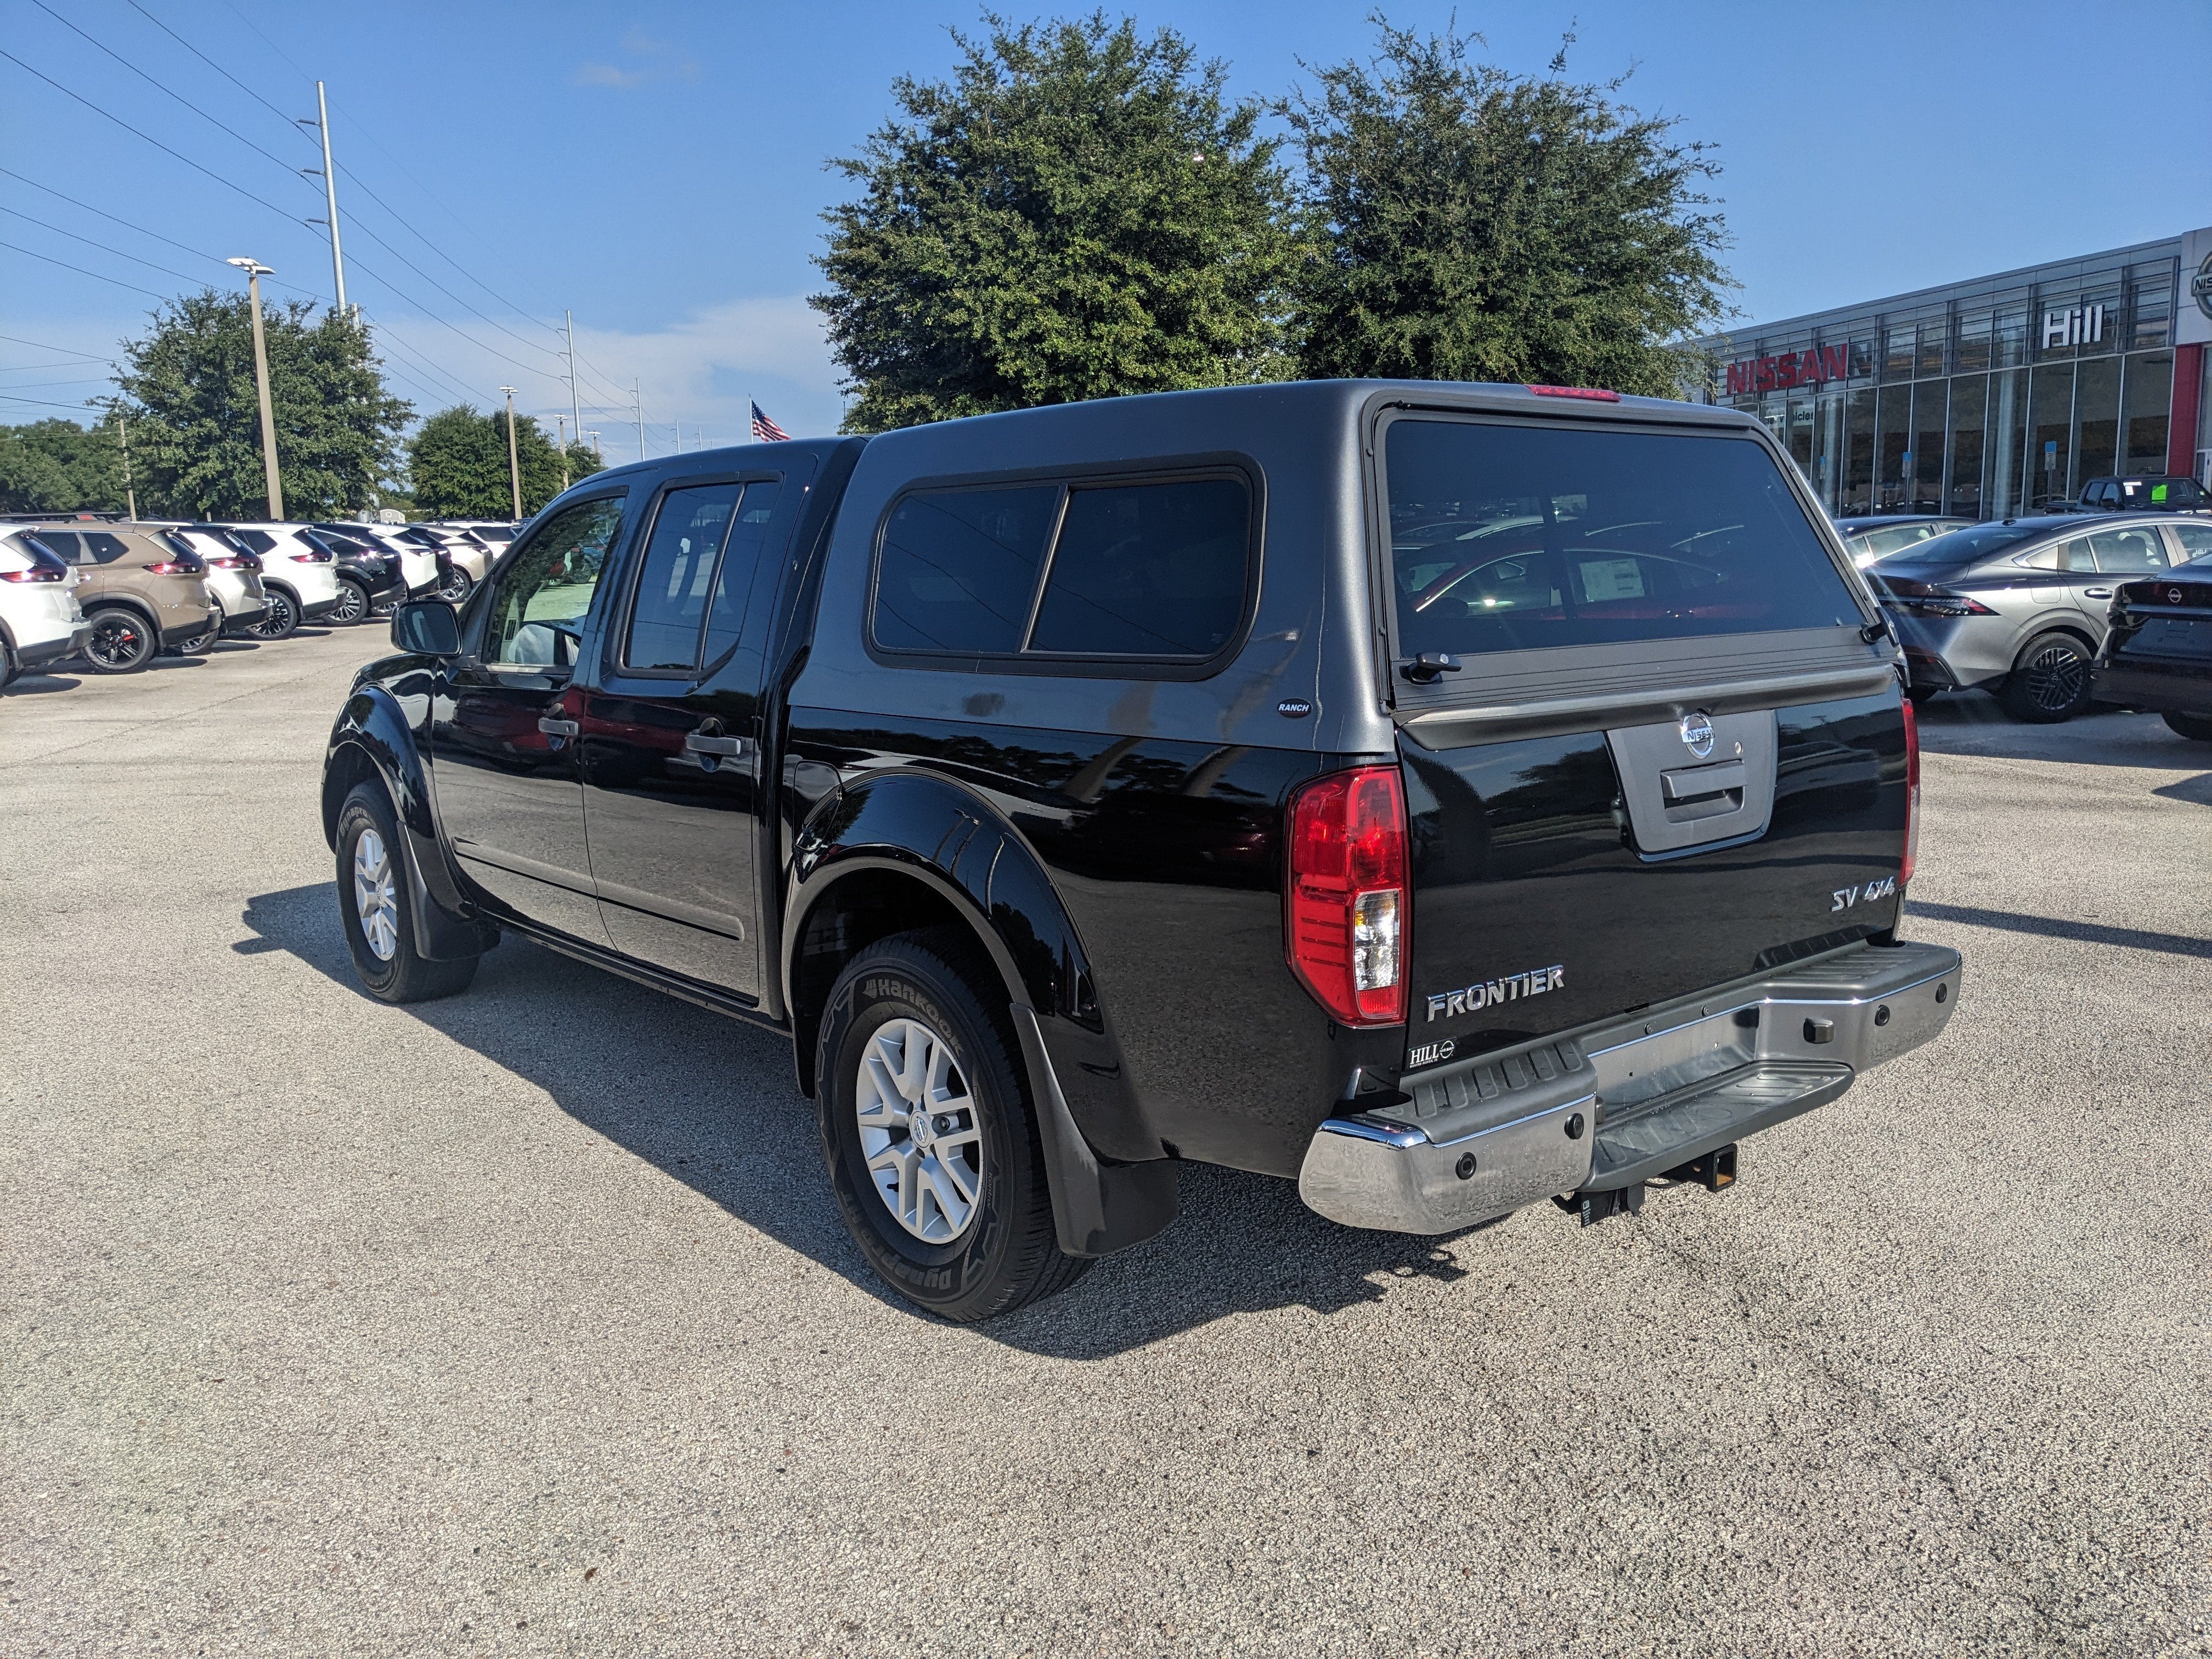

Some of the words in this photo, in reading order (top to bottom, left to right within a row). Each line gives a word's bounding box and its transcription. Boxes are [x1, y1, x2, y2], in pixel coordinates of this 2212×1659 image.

[2042, 304, 2104, 349] Hill
[1726, 343, 1848, 395] NISSAN
[1278, 704, 1310, 712] RANCH
[1687, 729, 1713, 742] NISSAN
[1831, 886, 1859, 912] SV
[1427, 964, 1565, 1023] FRONTIER
[1410, 1044, 1439, 1065] HILL
